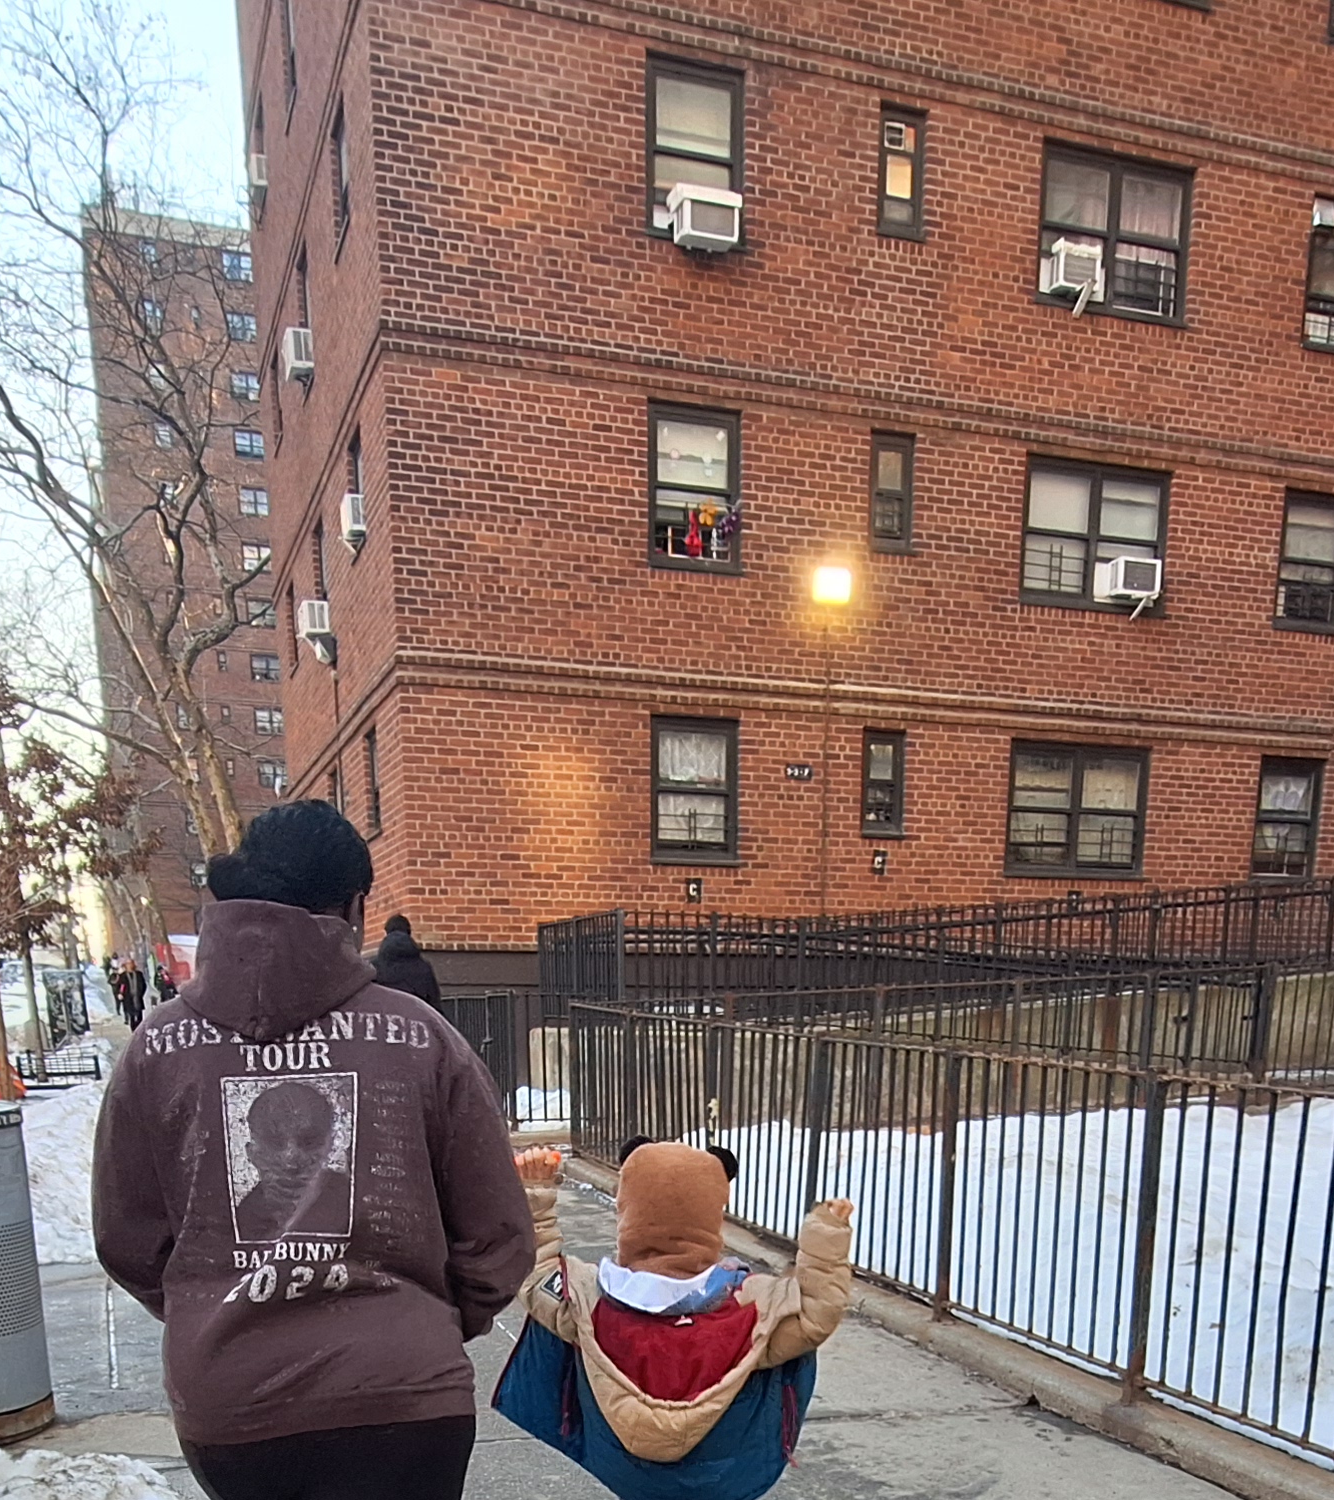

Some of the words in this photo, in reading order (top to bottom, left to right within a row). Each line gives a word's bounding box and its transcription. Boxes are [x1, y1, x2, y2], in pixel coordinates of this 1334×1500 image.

[874, 856, 883, 869] C
[689, 883, 698, 896] C
[275, 1011, 430, 1049] ANTED
[239, 1041, 333, 1072] TOUR
[273, 1242, 351, 1261] BUNNY
